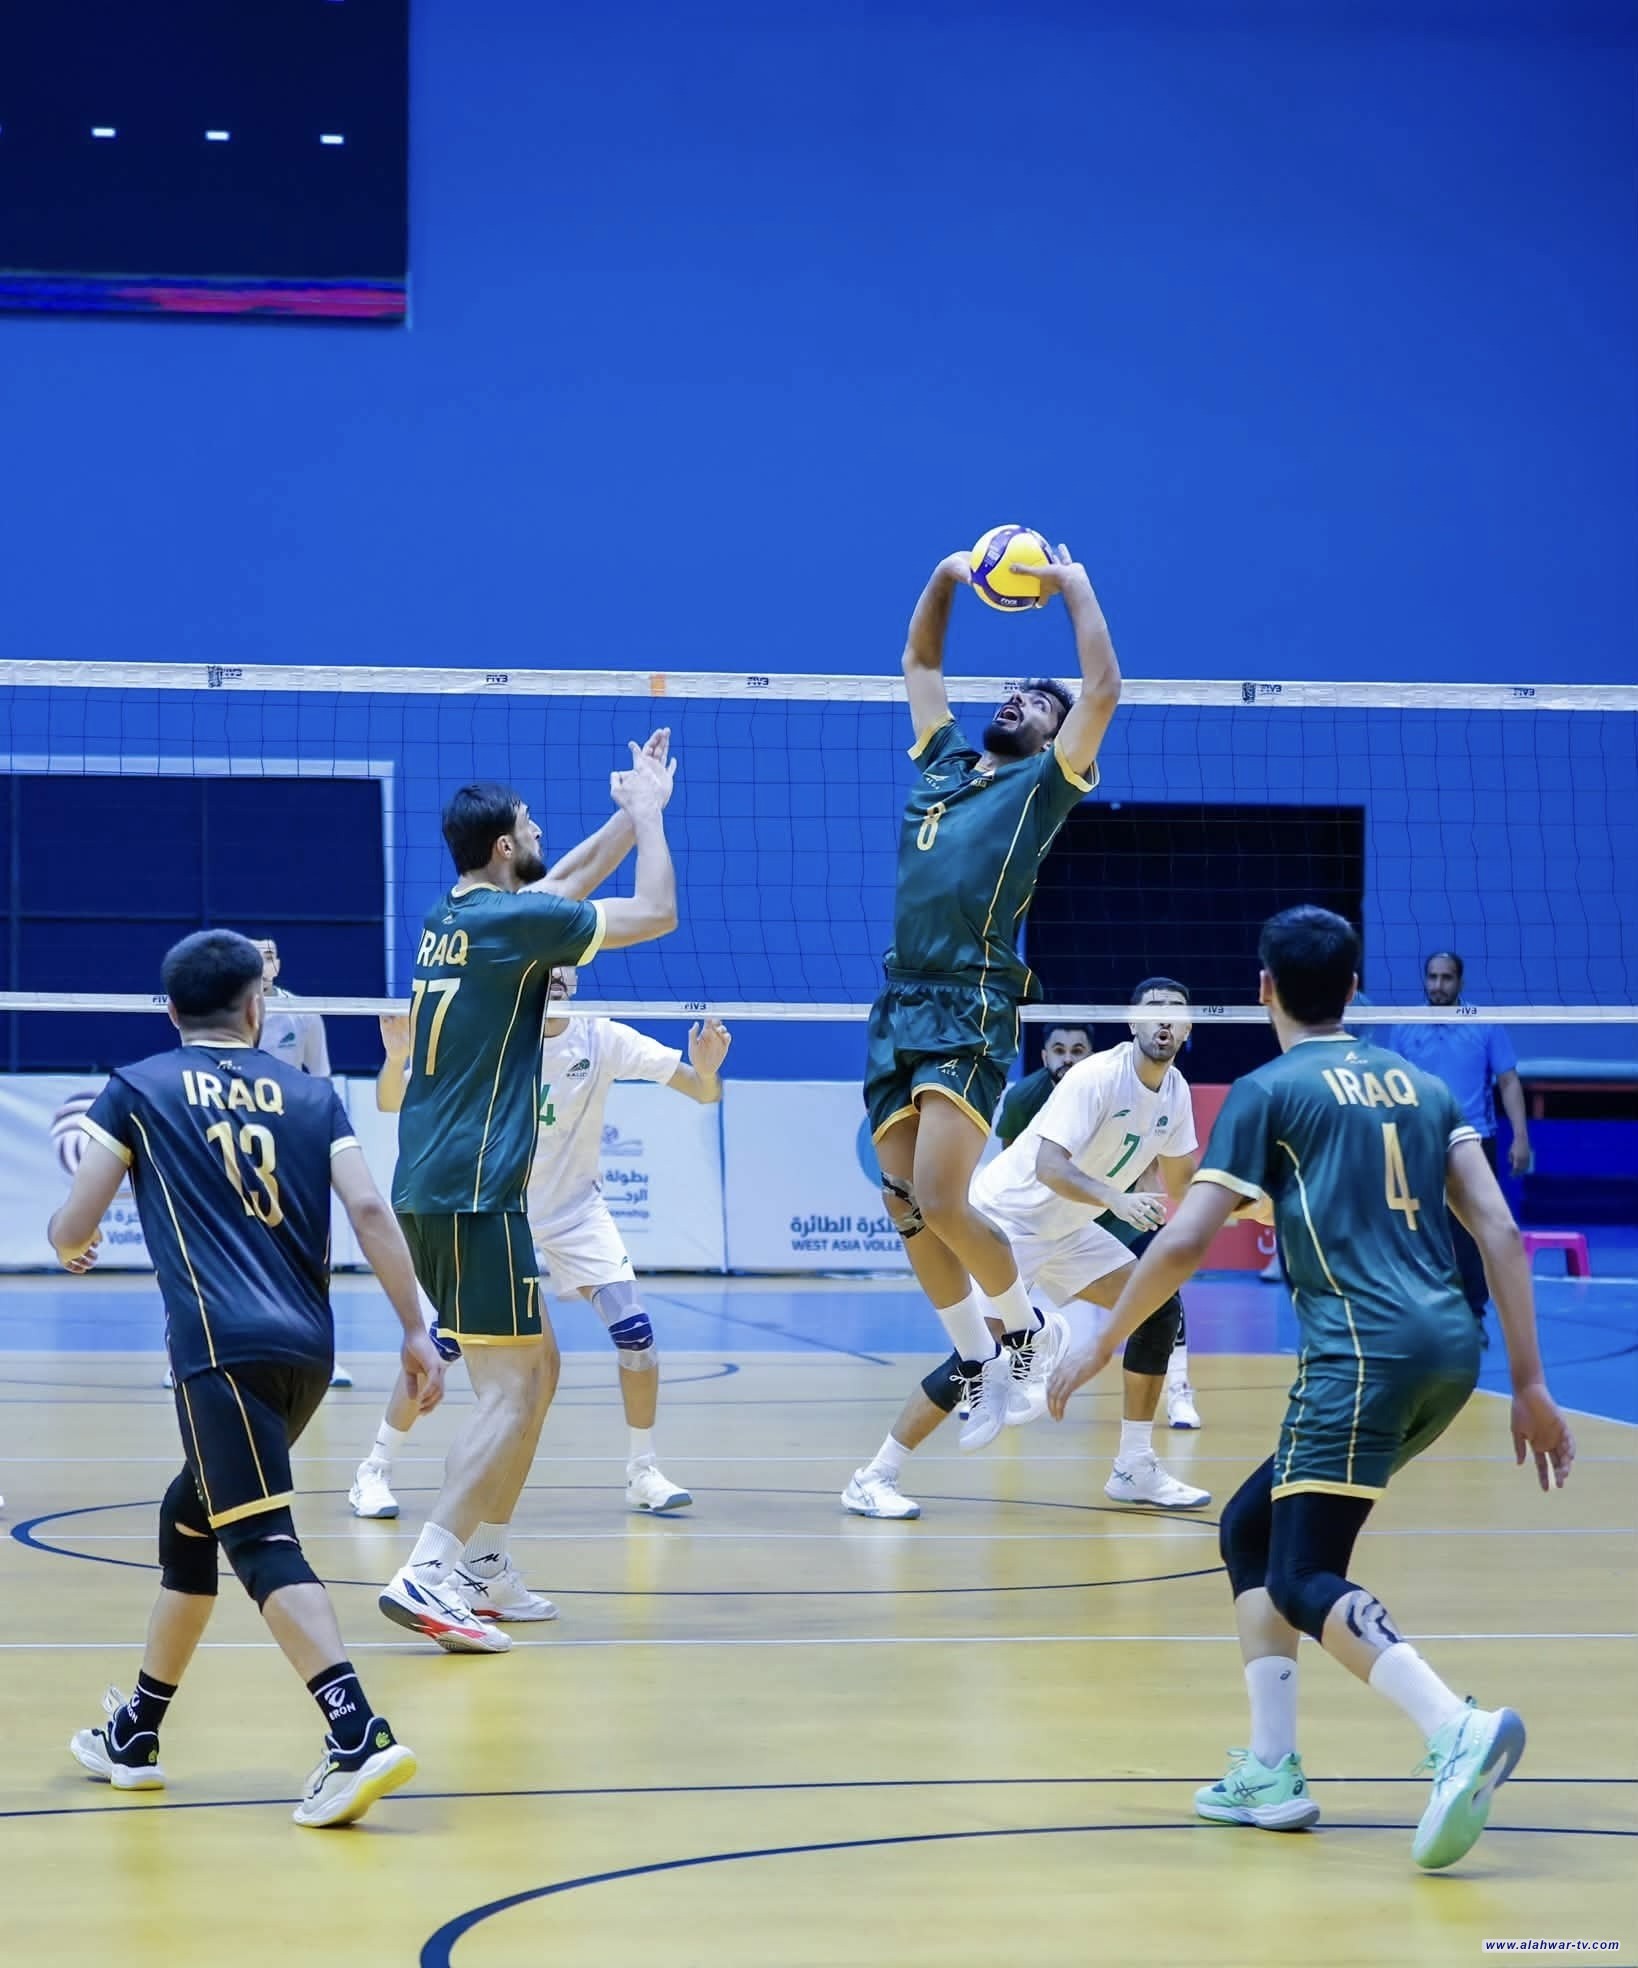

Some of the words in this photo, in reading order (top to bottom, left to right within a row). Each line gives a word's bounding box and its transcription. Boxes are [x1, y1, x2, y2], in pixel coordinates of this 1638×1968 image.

[416, 928, 469, 967] RAQ
[152, 995, 168, 1004] FIV
[182, 1069, 285, 1116] IRAQ
[1321, 1067, 1420, 1109] IRAQ
[206, 1120, 285, 1228] 13
[1106, 1132, 1141, 1179] 7
[1381, 1121, 1421, 1232] 4
[106, 1230, 143, 1245] Volle
[790, 1214, 852, 1238] الطائرة
[791, 1239, 829, 1252] WEST
[832, 1239, 861, 1252] ASIA
[863, 1239, 904, 1252] VOLLE
